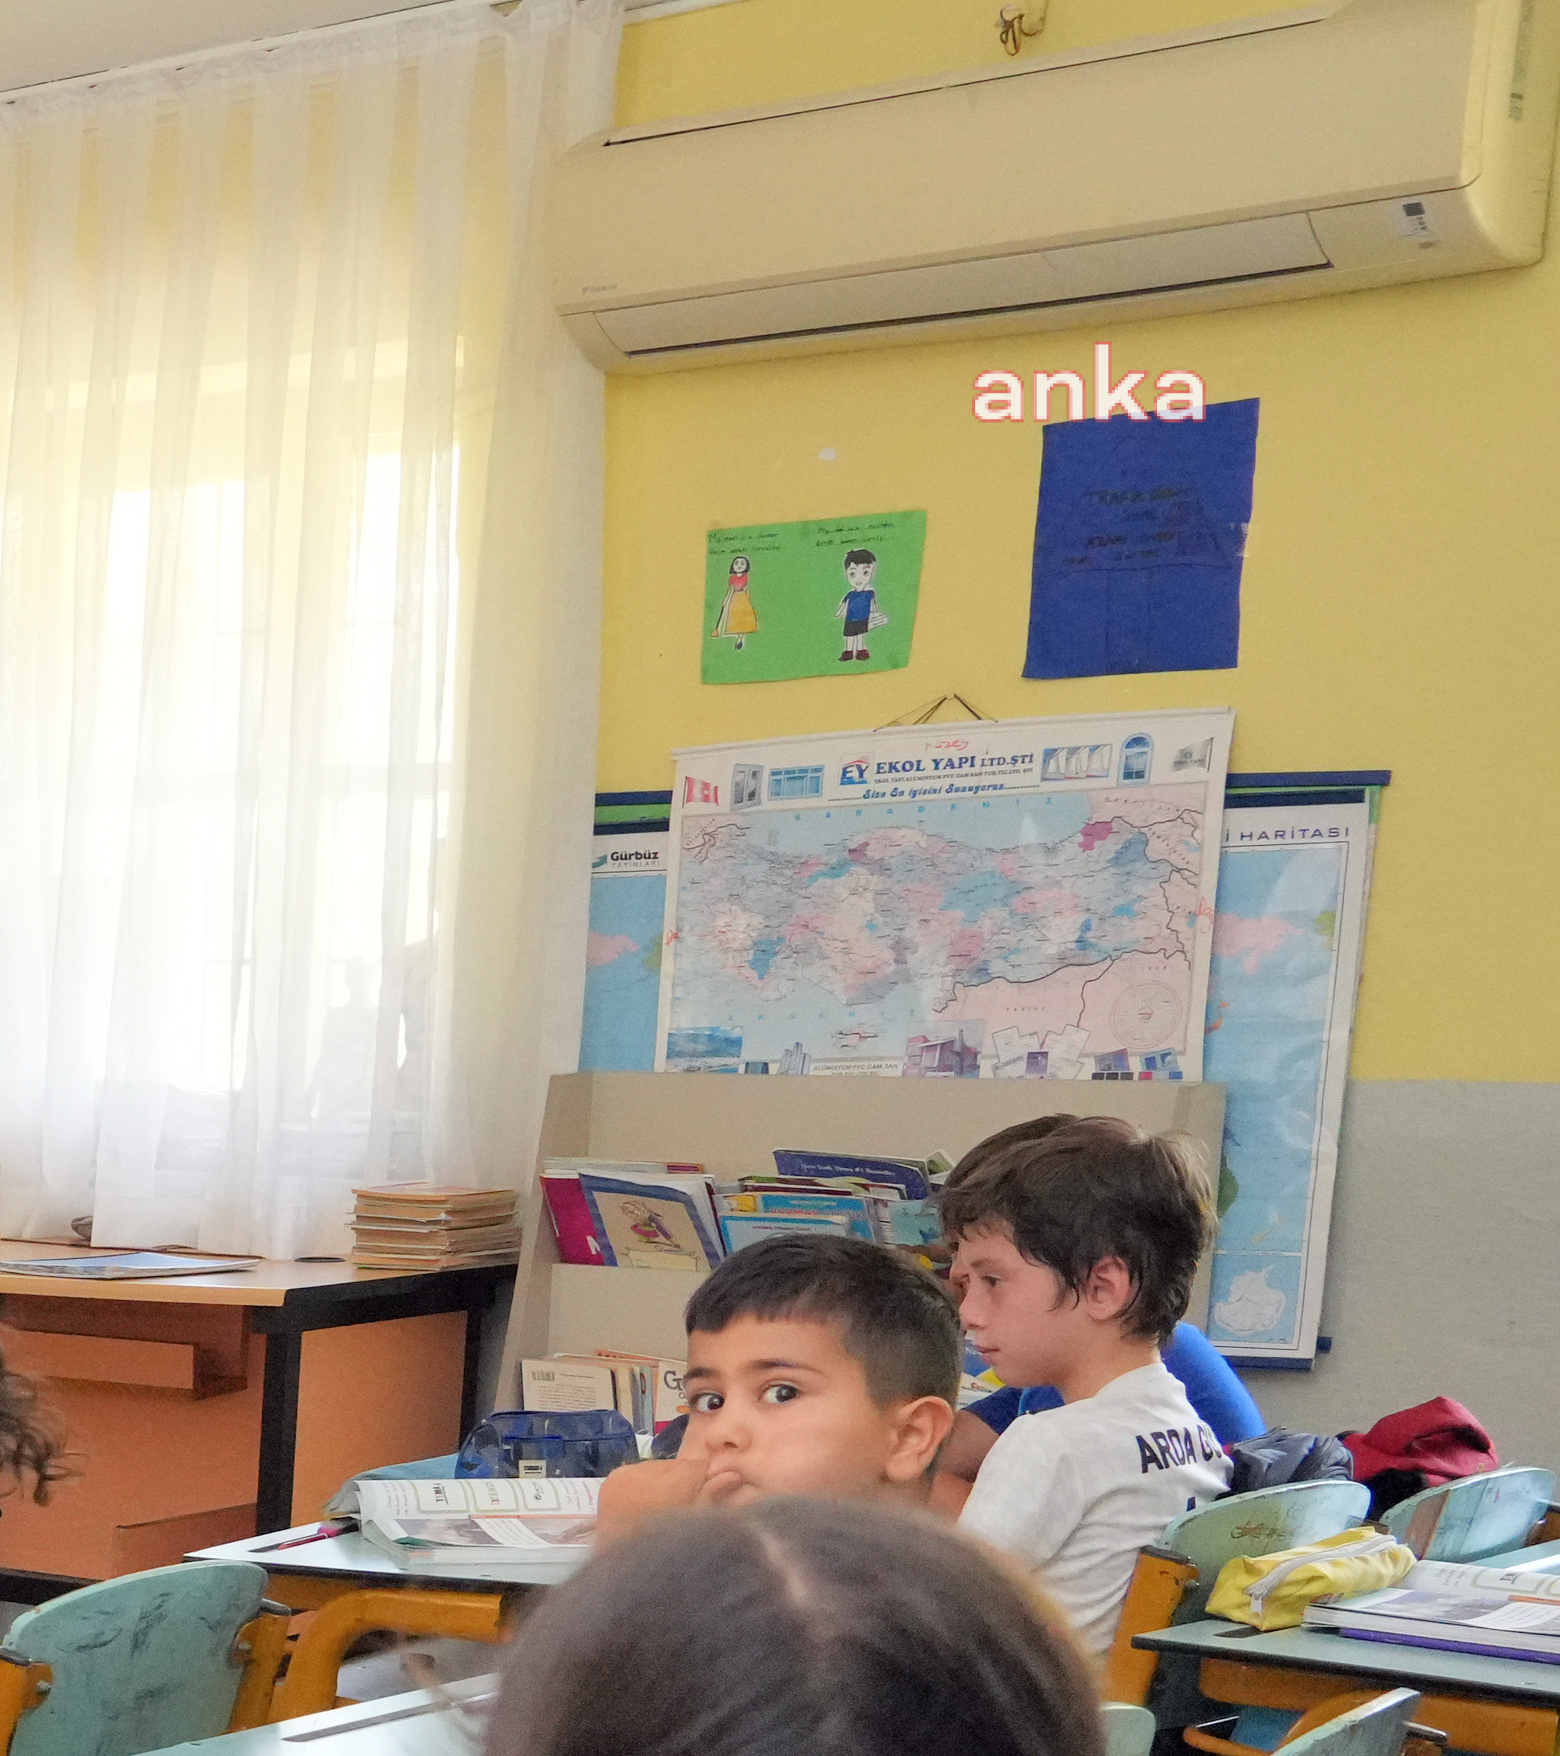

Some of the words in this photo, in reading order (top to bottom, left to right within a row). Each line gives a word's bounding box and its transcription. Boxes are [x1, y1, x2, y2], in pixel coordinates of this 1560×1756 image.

[875, 759, 926, 775] EKOL
[932, 756, 976, 771] YAPI
[1240, 826, 1349, 841] HARİTASI
[611, 850, 659, 861] Gürbüz
[1135, 1427, 1196, 1473] ARDA
